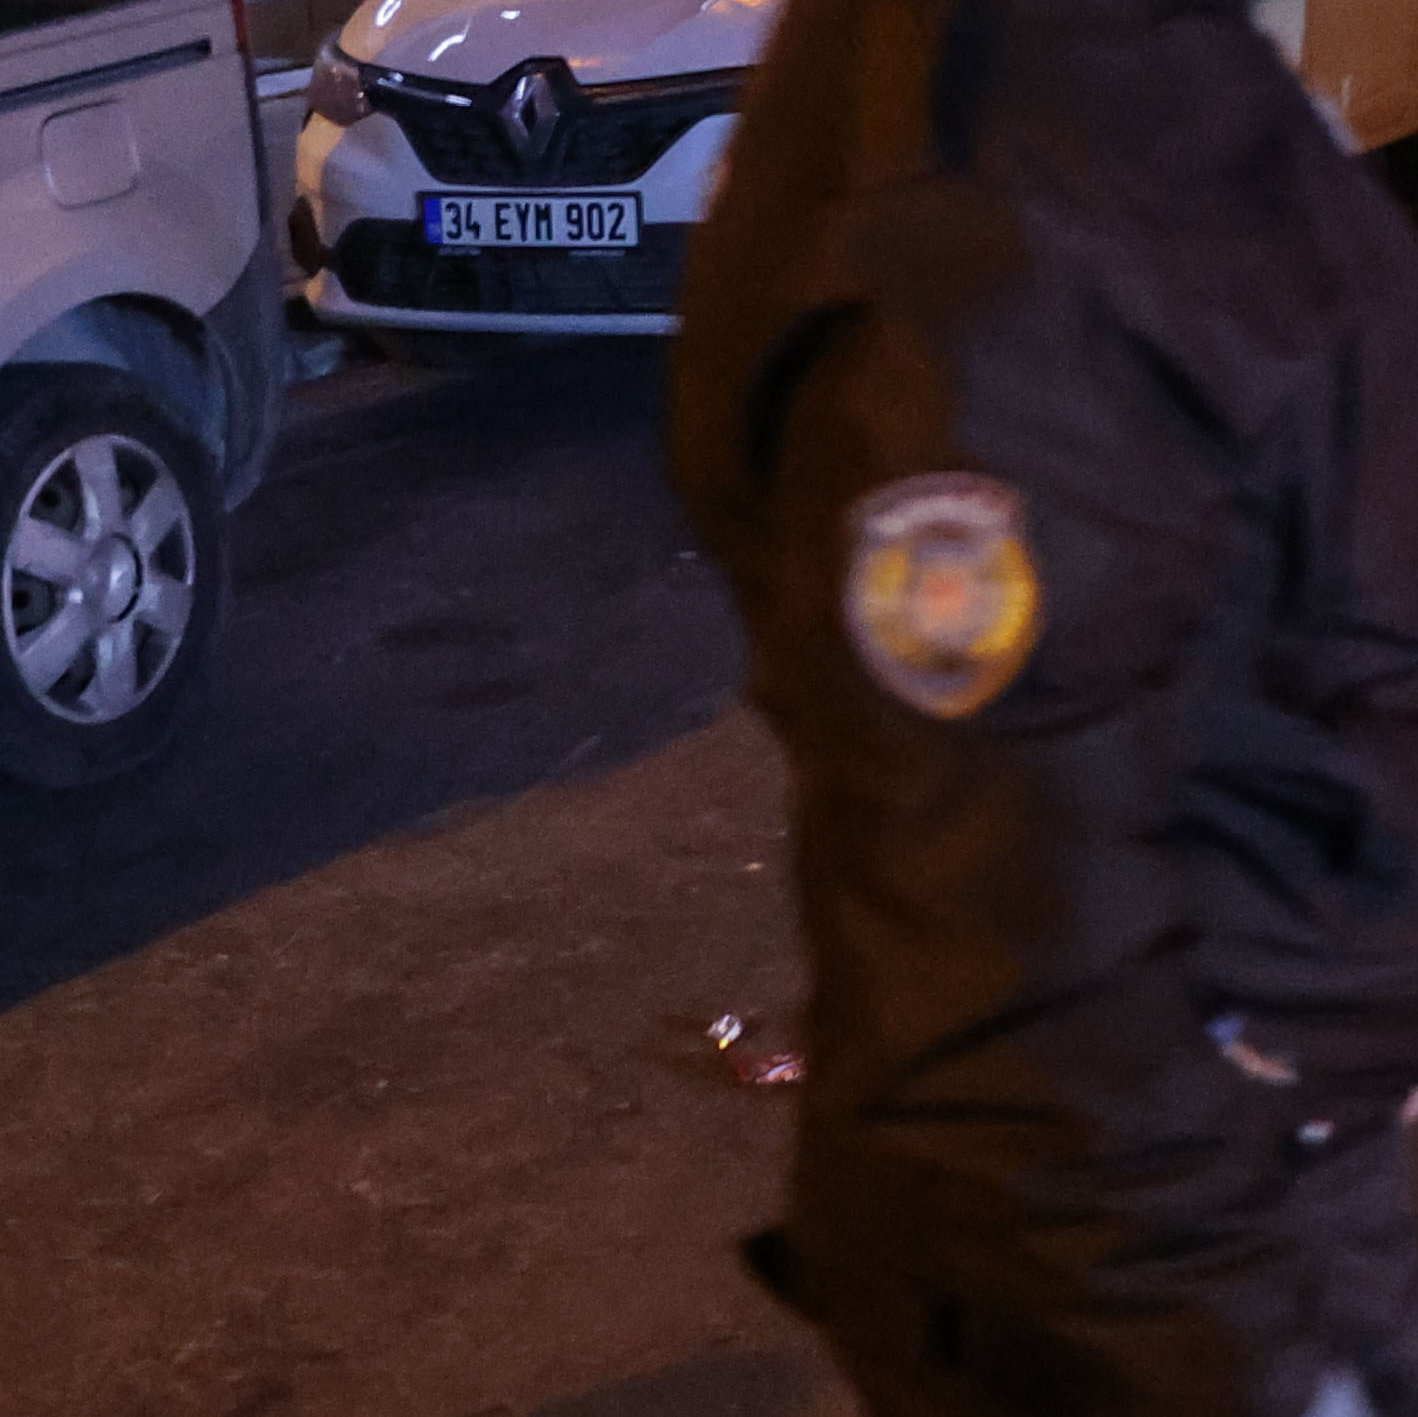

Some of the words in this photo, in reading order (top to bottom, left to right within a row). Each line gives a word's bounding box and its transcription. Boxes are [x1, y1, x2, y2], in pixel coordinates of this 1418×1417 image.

[444, 201, 482, 241] 34
[494, 201, 553, 242] EYM
[566, 201, 627, 242] 902
